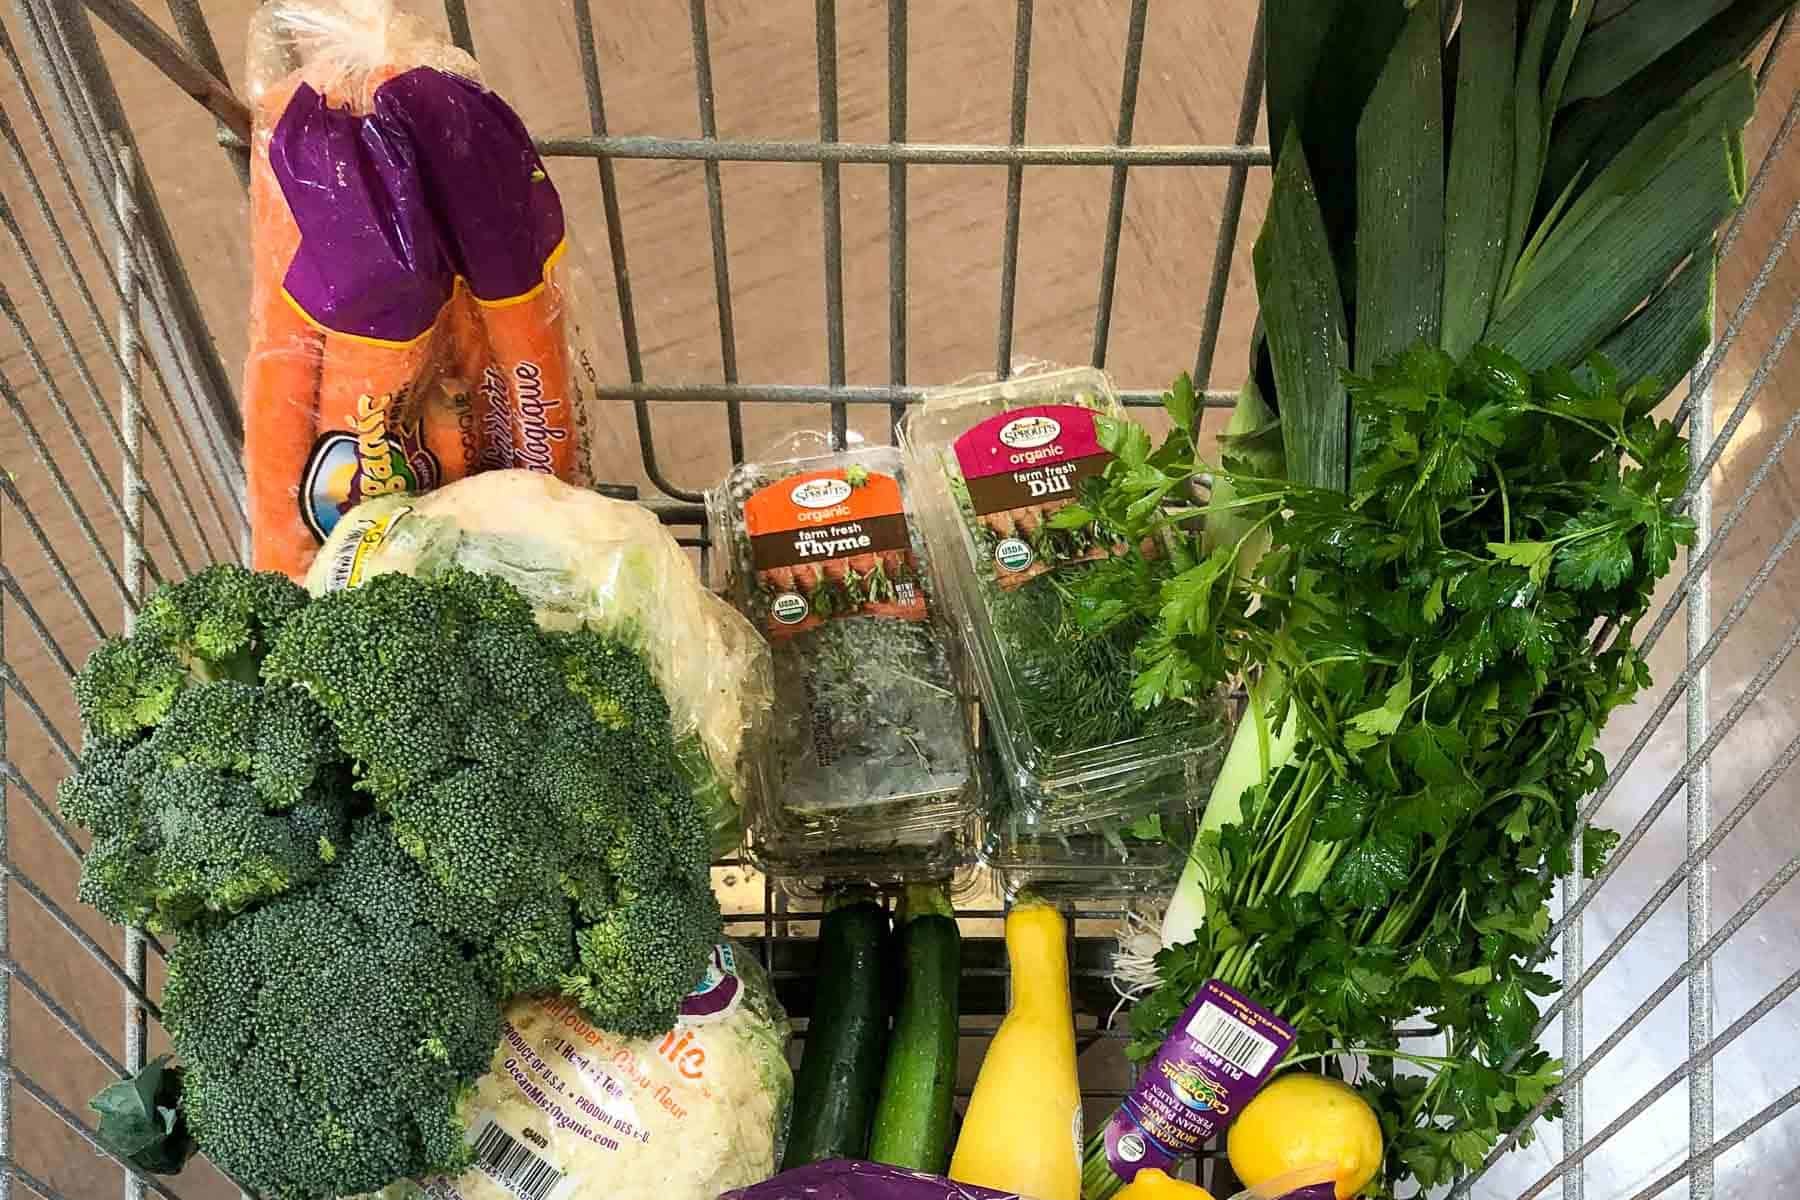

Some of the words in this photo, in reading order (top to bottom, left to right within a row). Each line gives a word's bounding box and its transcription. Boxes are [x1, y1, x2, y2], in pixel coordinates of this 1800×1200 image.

[514, 361, 566, 475] ologique
[344, 392, 406, 493] ganic
[1010, 445, 1064, 464] organic
[1014, 471, 1043, 483] farm
[1045, 463, 1077, 478] fresh
[1028, 476, 1072, 497] Dill
[797, 506, 851, 523] organic
[799, 528, 828, 541] farm
[831, 523, 862, 537] fresh
[794, 533, 871, 557] Thyme
[1222, 1063, 1244, 1081] PLU
[1160, 1064, 1230, 1116] Cal-Organic
[1142, 1090, 1178, 1120] PARSLEY
[1140, 1115, 1184, 1147] ORGANIC
